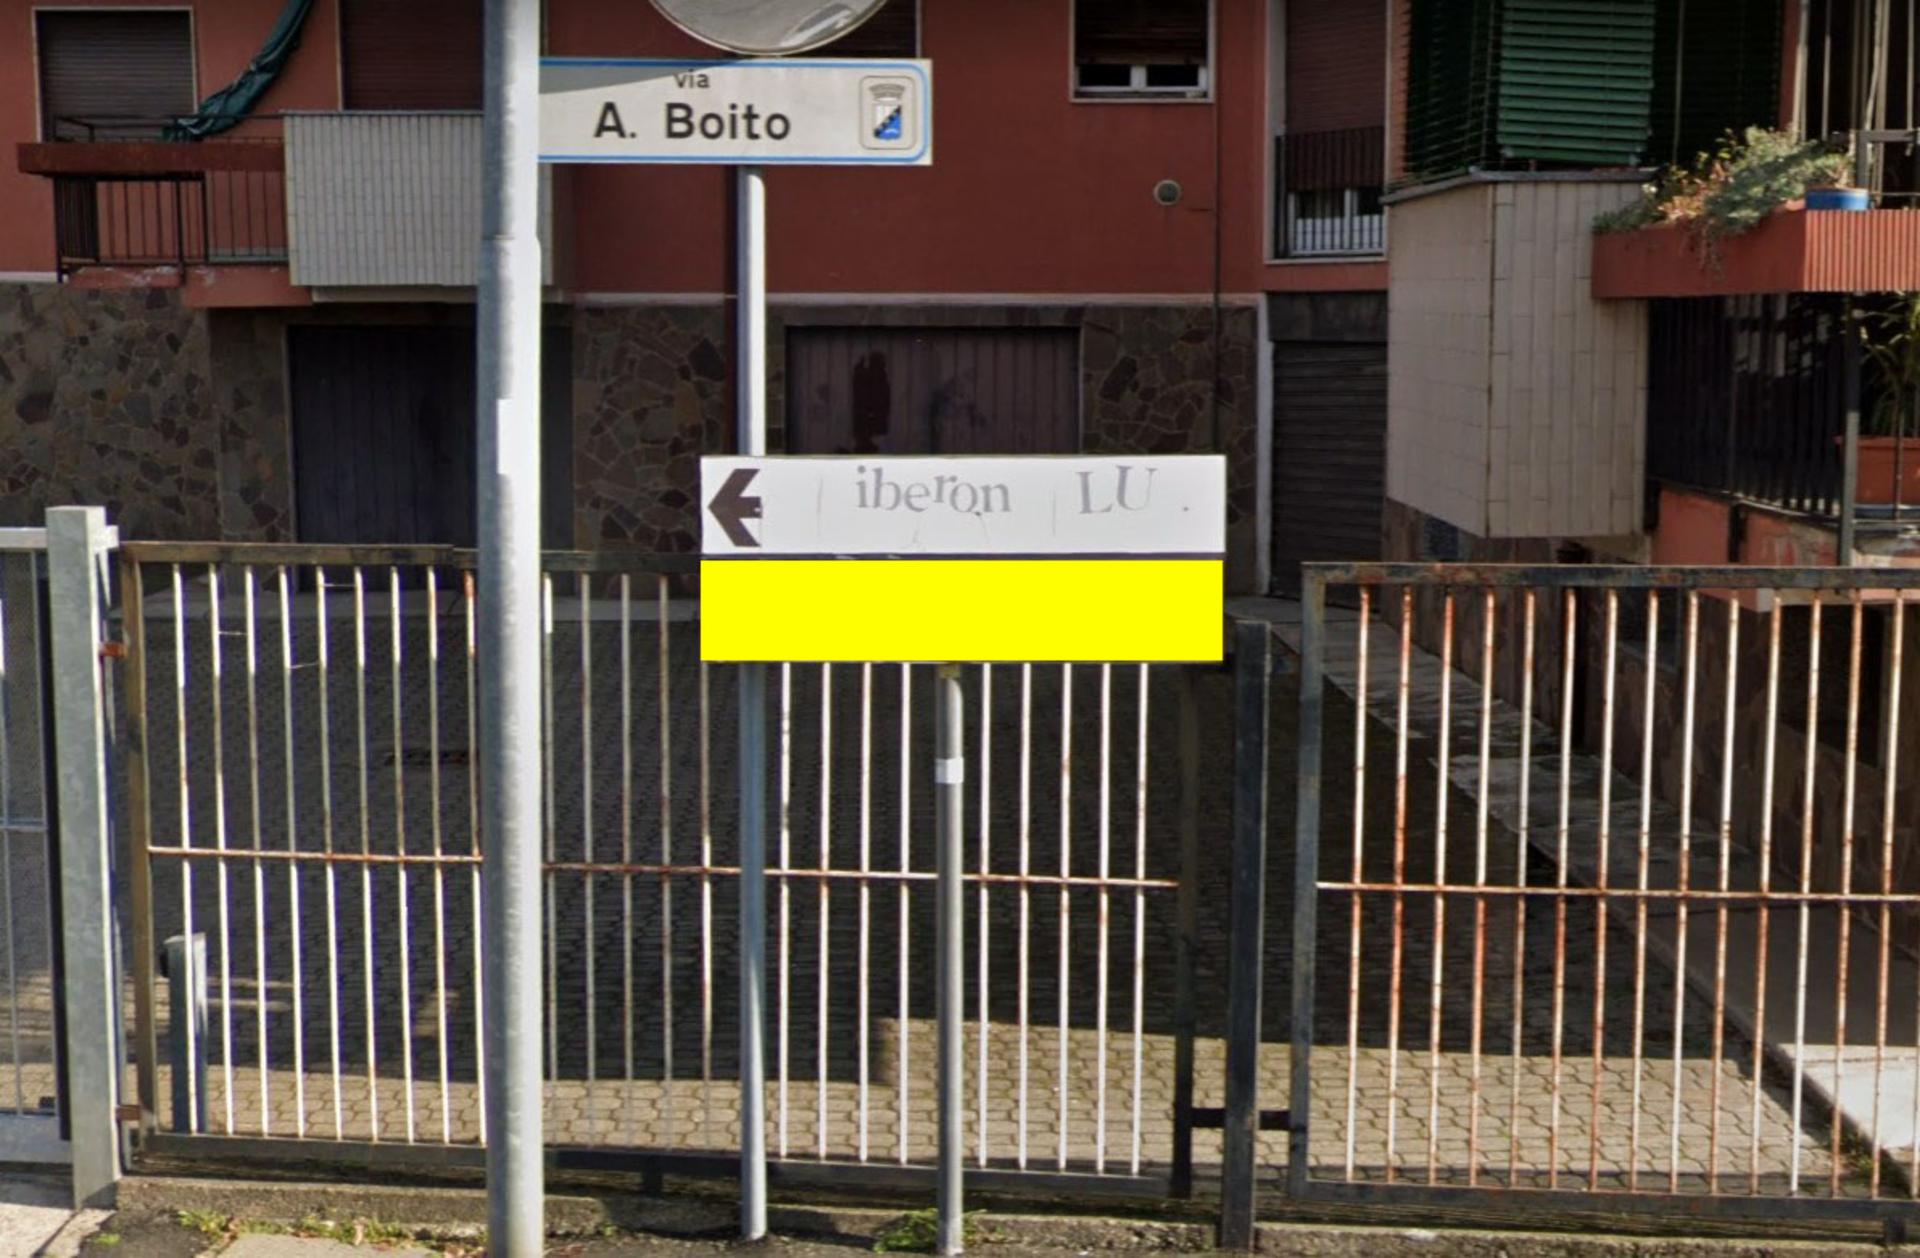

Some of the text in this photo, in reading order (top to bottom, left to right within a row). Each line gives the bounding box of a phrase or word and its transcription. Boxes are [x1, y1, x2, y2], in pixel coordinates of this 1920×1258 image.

[674, 68, 711, 89] via
[593, 101, 791, 140] A. Boito
